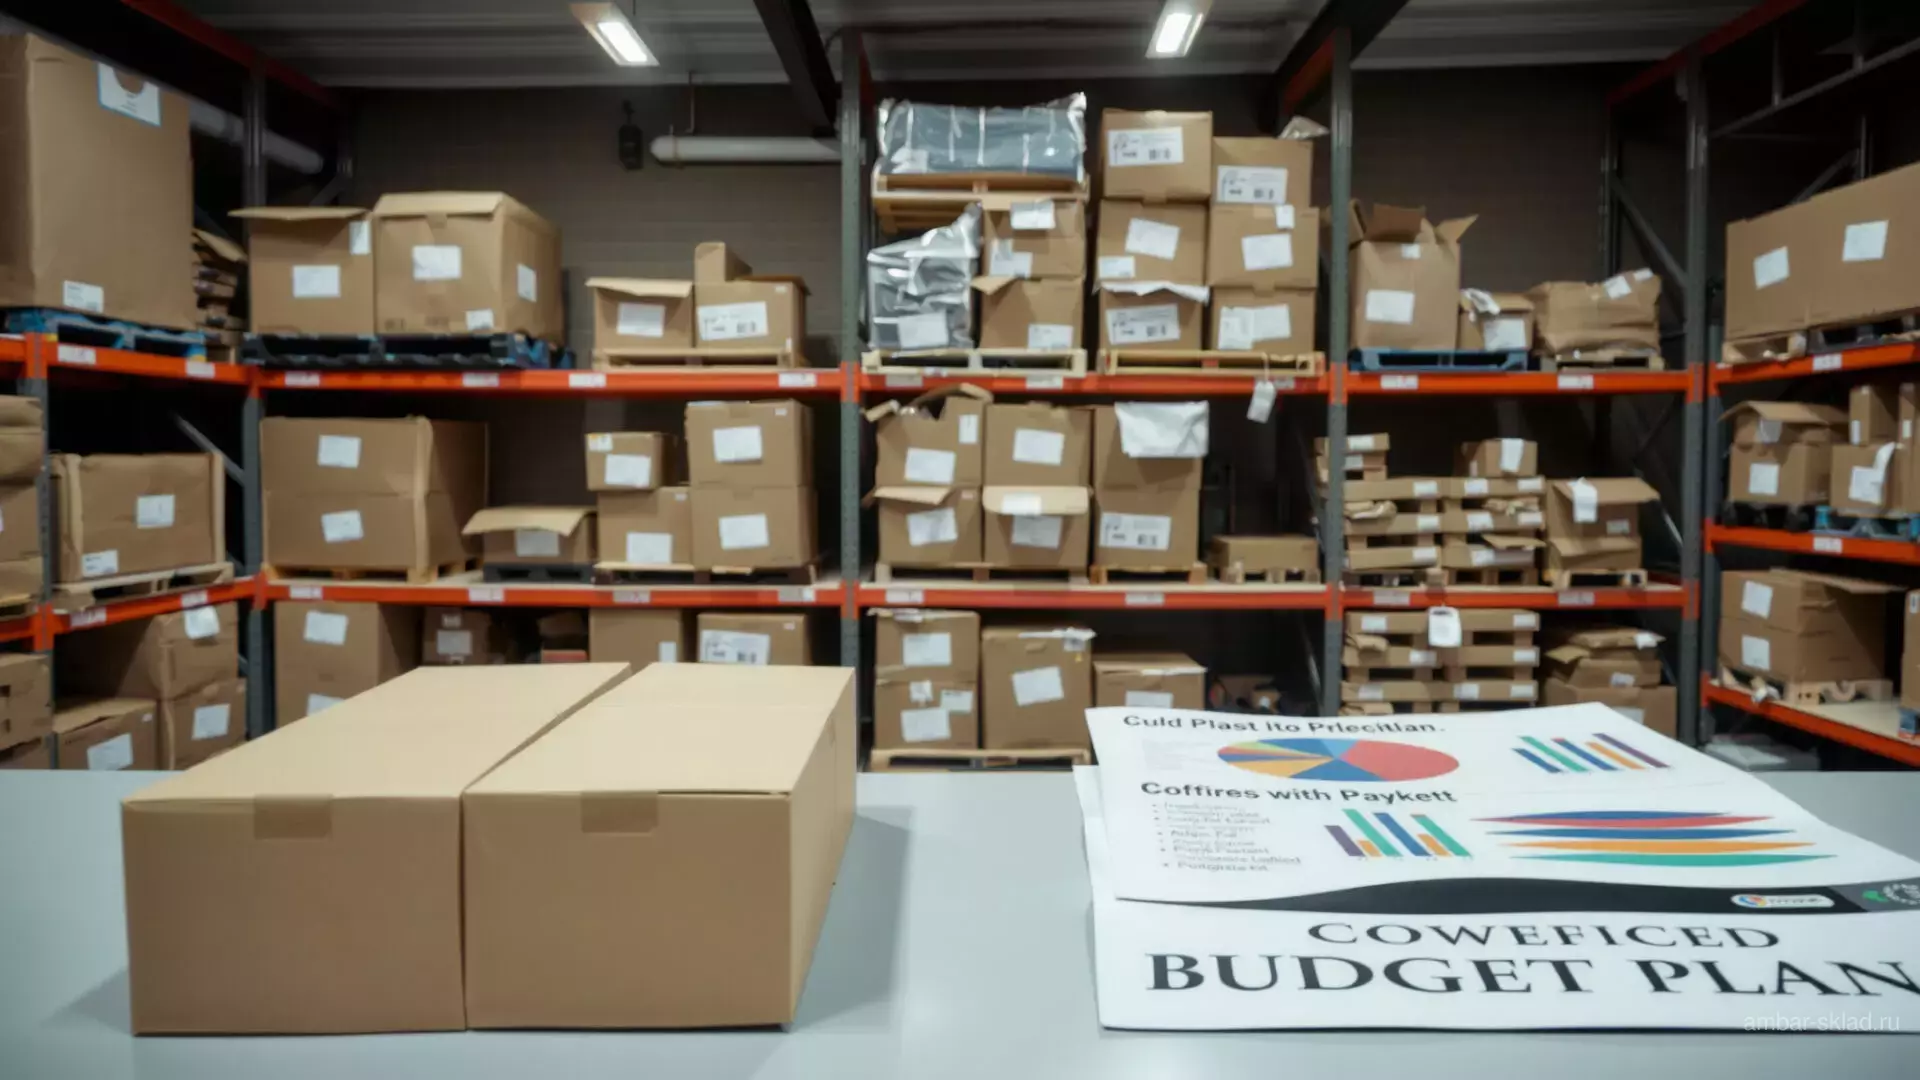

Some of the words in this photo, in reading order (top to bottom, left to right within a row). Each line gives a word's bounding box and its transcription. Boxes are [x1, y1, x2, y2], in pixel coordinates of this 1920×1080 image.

[1266, 788, 1332, 801] with
[1339, 789, 1458, 806] Paykett
[1308, 922, 1780, 949] COWEFICED
[1146, 953, 1595, 994] BUDGET
[1629, 958, 1920, 997] PLAN
